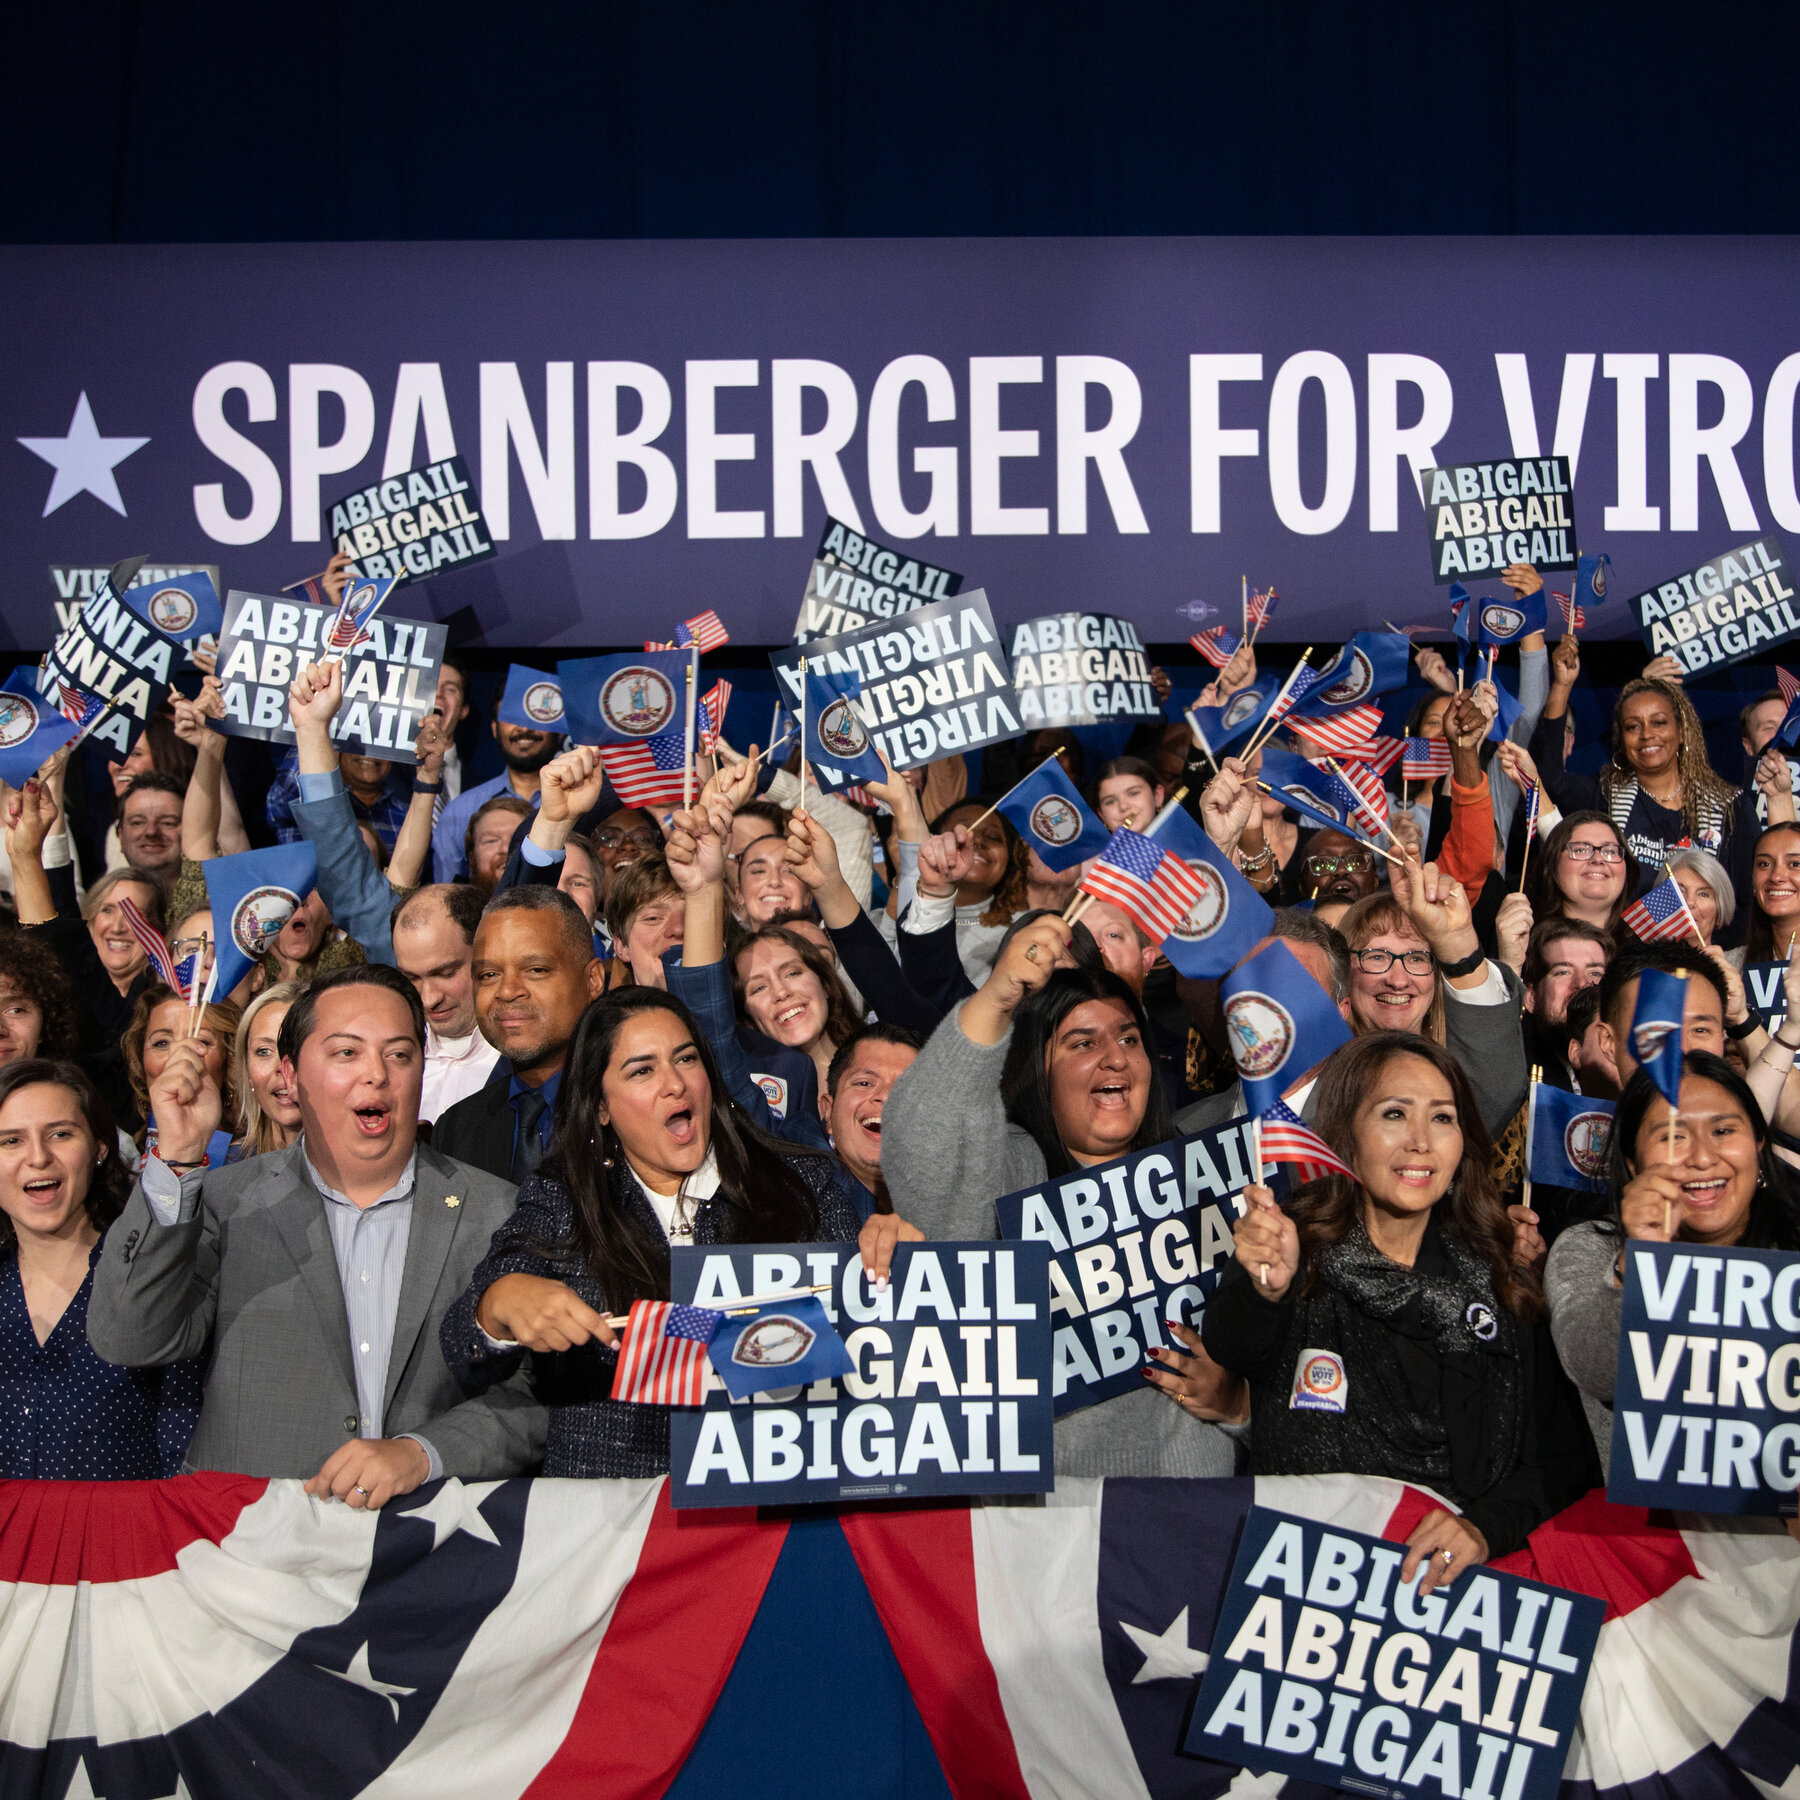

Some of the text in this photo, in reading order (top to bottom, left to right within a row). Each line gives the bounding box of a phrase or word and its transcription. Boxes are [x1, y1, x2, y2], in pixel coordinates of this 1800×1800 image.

[193, 354, 1150, 545] SPANBERGER
[1190, 350, 1453, 536] FOR
[1431, 460, 1569, 506] ABIGAIL
[332, 462, 469, 539] ABIGAIL
[338, 492, 480, 562] ABIGAIL
[1435, 494, 1572, 541] ABIGAIL
[823, 523, 951, 601] ABIGAIL
[1439, 529, 1574, 576] ABIGAIL
[1640, 541, 1782, 628] ABIGAIL
[816, 565, 932, 619] VIRGI
[1651, 570, 1795, 656] ABIGAIL
[1012, 615, 1145, 657] ABIGAIL
[1014, 649, 1153, 689] ABIGAIL
[1020, 682, 1161, 721] ABIGAIL
[1627, 833, 1664, 850] Abigail
[692, 1250, 1037, 1323] ABIGAIL
[1049, 1193, 1248, 1320] ABIGA
[1052, 1272, 1223, 1398] ABIG
[1312, 1370, 1333, 1380] VOTE
[686, 1401, 1041, 1486] ABIGAIL
[1622, 1410, 1800, 1492] VIRG
[1244, 1520, 1579, 1675] ABIGAIL
[1224, 1594, 1560, 1747] ABIGAIL
